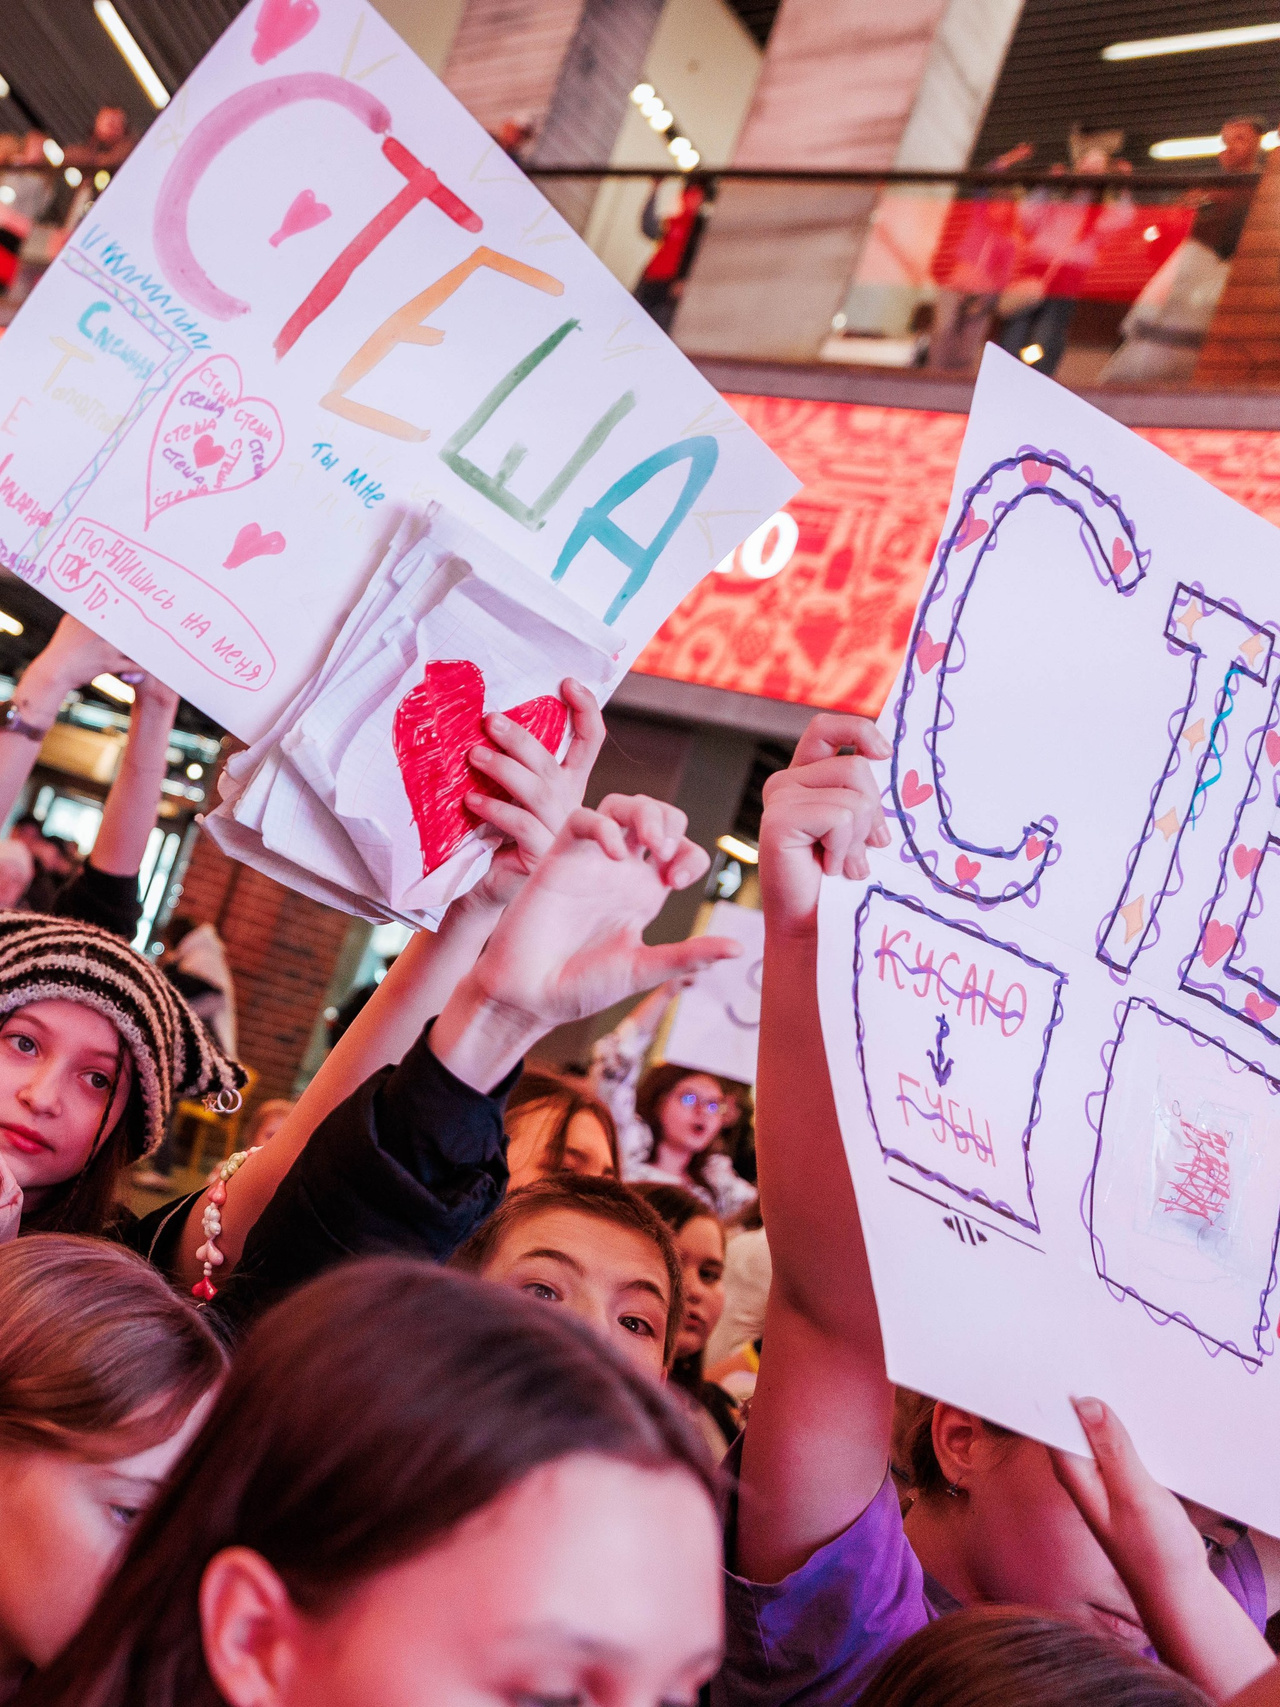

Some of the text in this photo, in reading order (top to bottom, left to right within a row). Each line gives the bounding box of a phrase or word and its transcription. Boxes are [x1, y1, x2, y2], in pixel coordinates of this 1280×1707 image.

[152, 71, 719, 626] СТЕША
[876, 924, 1027, 1037] КУСАЮ
[897, 1072, 996, 1167] ГУБЫ
